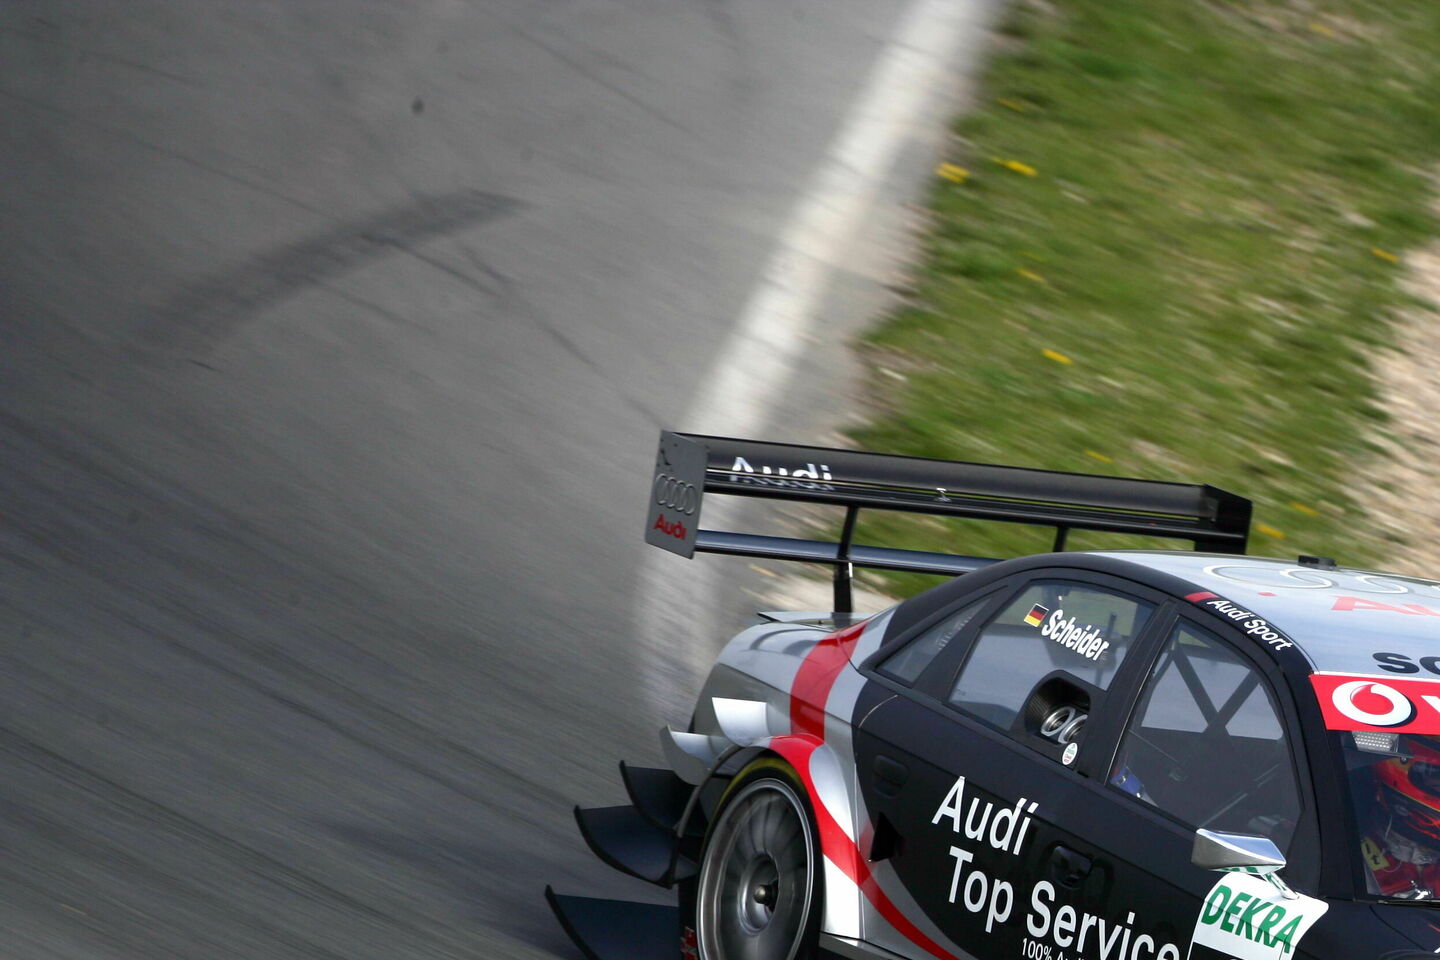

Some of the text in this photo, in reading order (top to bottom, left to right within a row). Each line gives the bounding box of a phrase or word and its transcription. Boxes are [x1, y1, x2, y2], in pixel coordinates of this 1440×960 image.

[653, 513, 688, 541] Audi
[1041, 609, 1110, 661] Scheider
[1206, 600, 1293, 651] Audi Sport
[931, 775, 1039, 856] Audi
[948, 845, 1014, 933] Top
[1201, 884, 1303, 954] DEKRA
